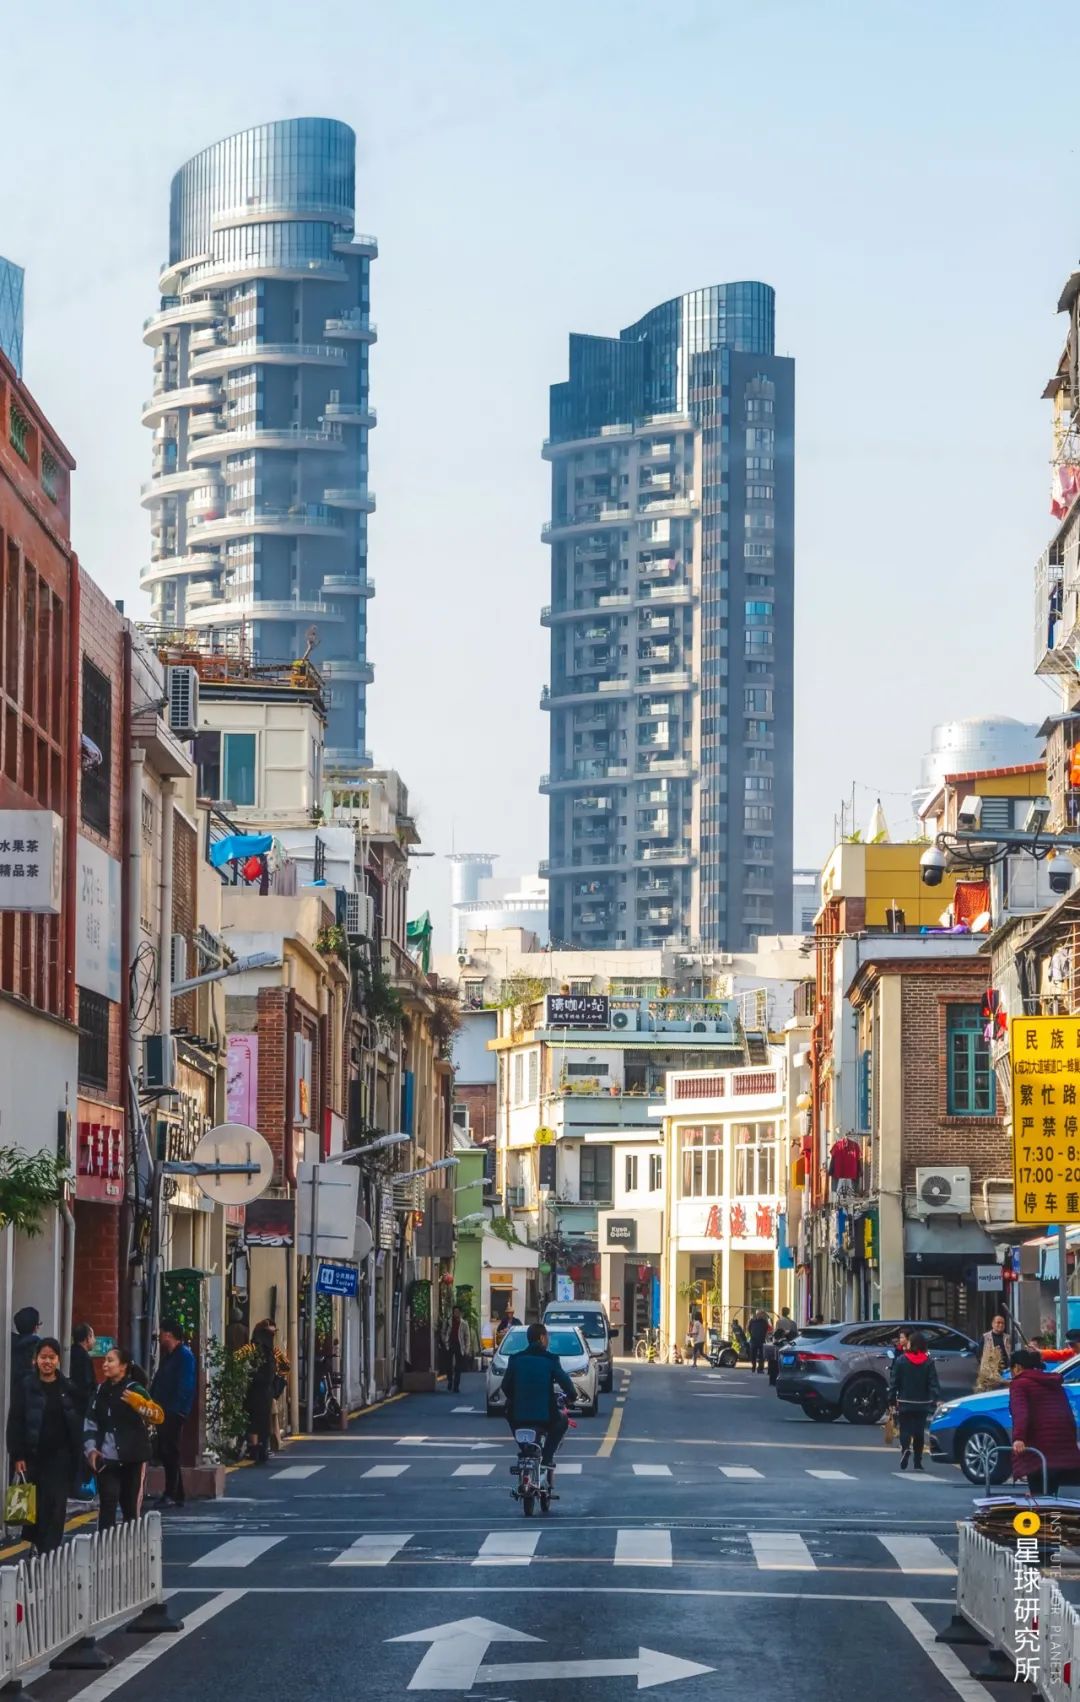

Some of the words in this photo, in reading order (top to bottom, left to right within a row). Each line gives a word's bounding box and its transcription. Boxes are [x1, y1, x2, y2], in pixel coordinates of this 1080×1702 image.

[0, 839, 39, 853] 水果茶
[0, 863, 39, 878] 精品茶
[1026, 1028, 1080, 1050] 民族
[1020, 1083, 1077, 1106] 繁忙路
[1020, 1115, 1078, 1138] 严禁停
[1023, 1191, 1080, 1214] 停车重
